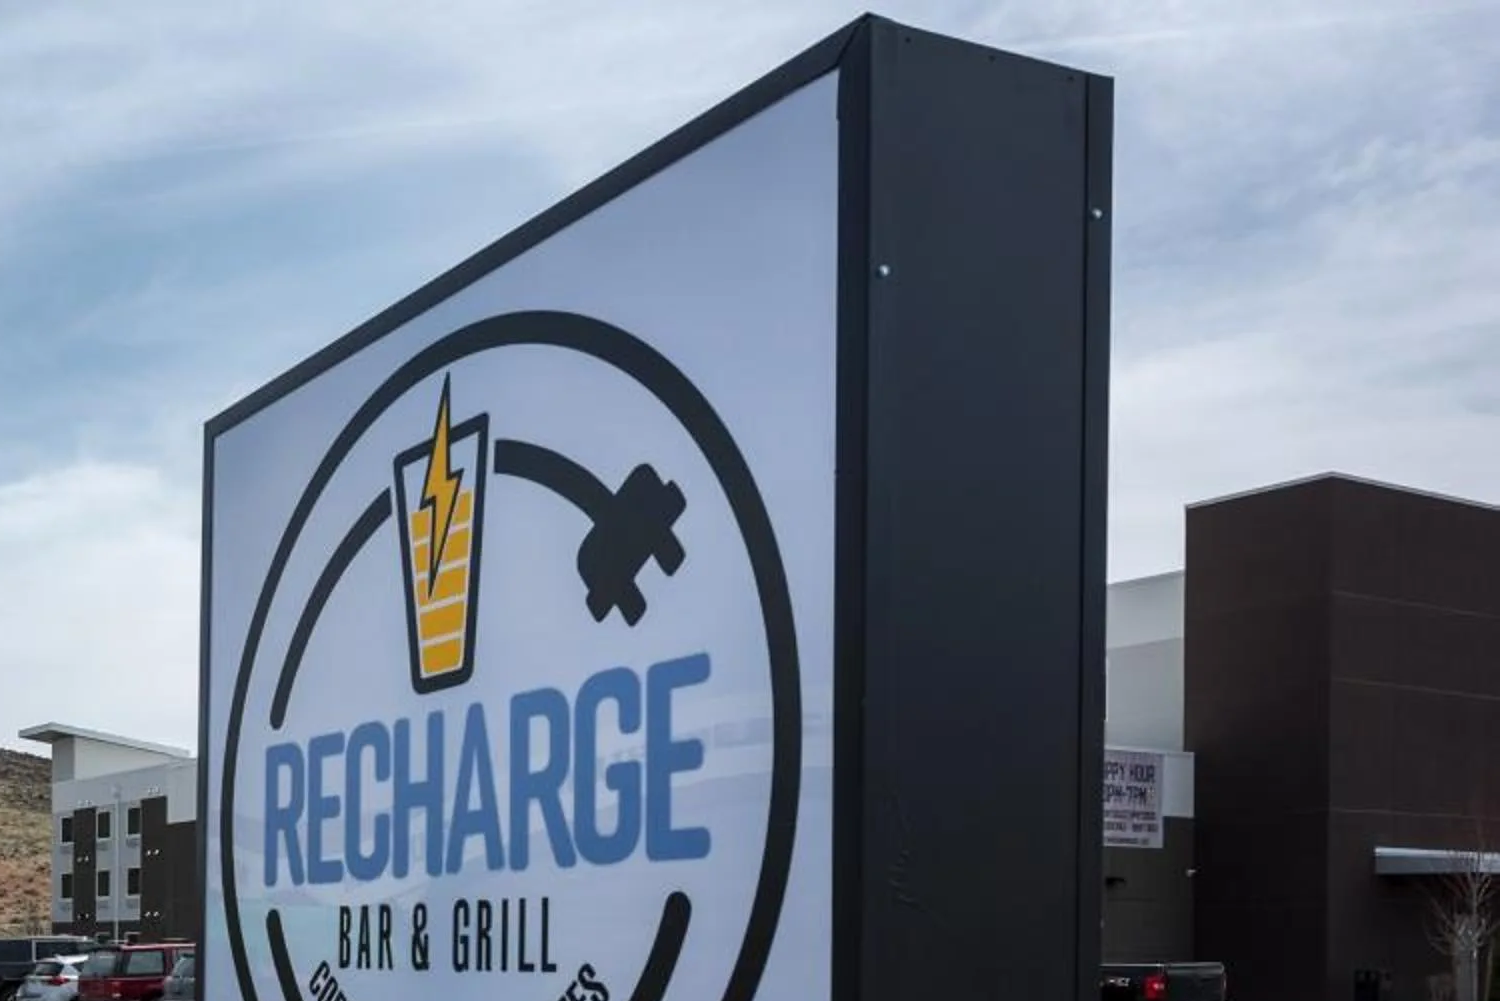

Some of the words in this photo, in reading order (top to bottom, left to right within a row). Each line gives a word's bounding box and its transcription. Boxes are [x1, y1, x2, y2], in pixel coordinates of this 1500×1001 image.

[263, 652, 711, 886] RECHARGE
[338, 904, 393, 971] BAR
[411, 903, 429, 970] &
[452, 896, 557, 973] GRILL
